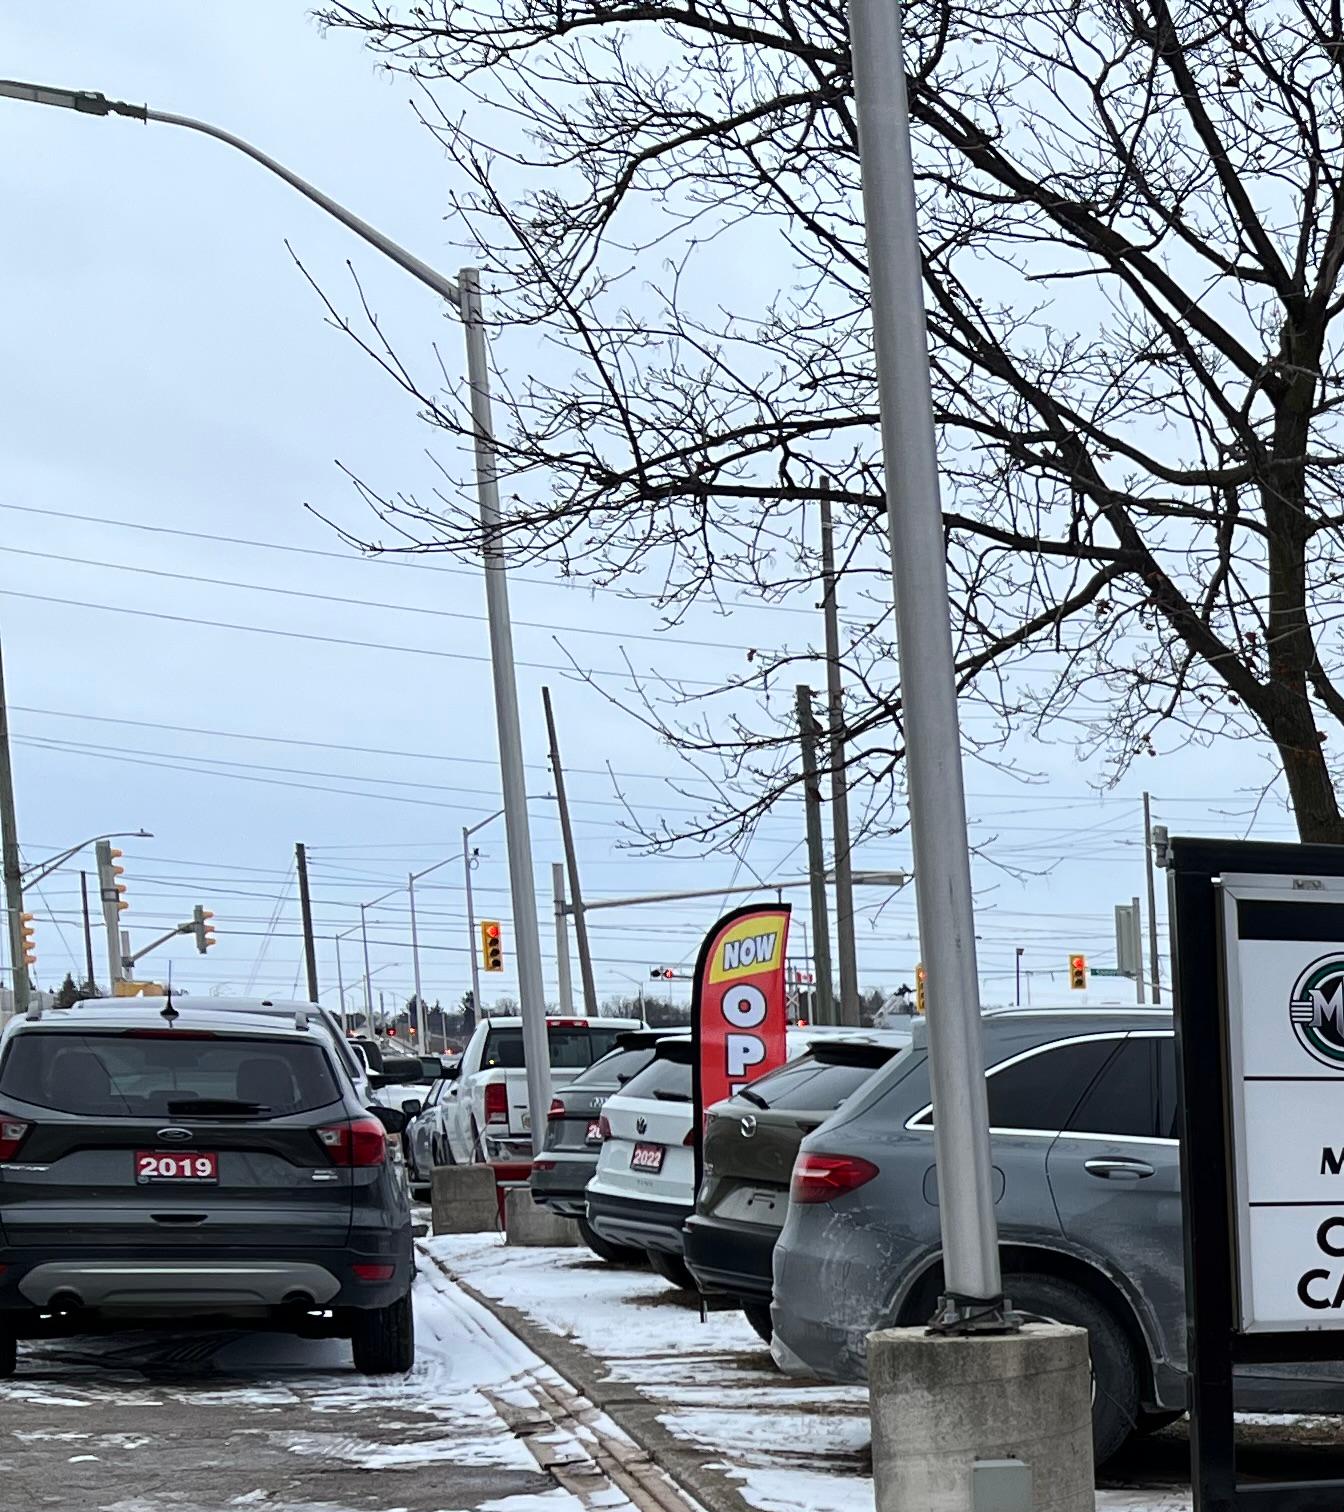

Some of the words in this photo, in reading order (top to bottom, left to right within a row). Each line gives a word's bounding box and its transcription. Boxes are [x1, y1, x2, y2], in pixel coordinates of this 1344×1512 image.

[723, 931, 777, 972] NOW
[140, 1157, 212, 1177] 2019
[633, 1149, 661, 1167] 2022
